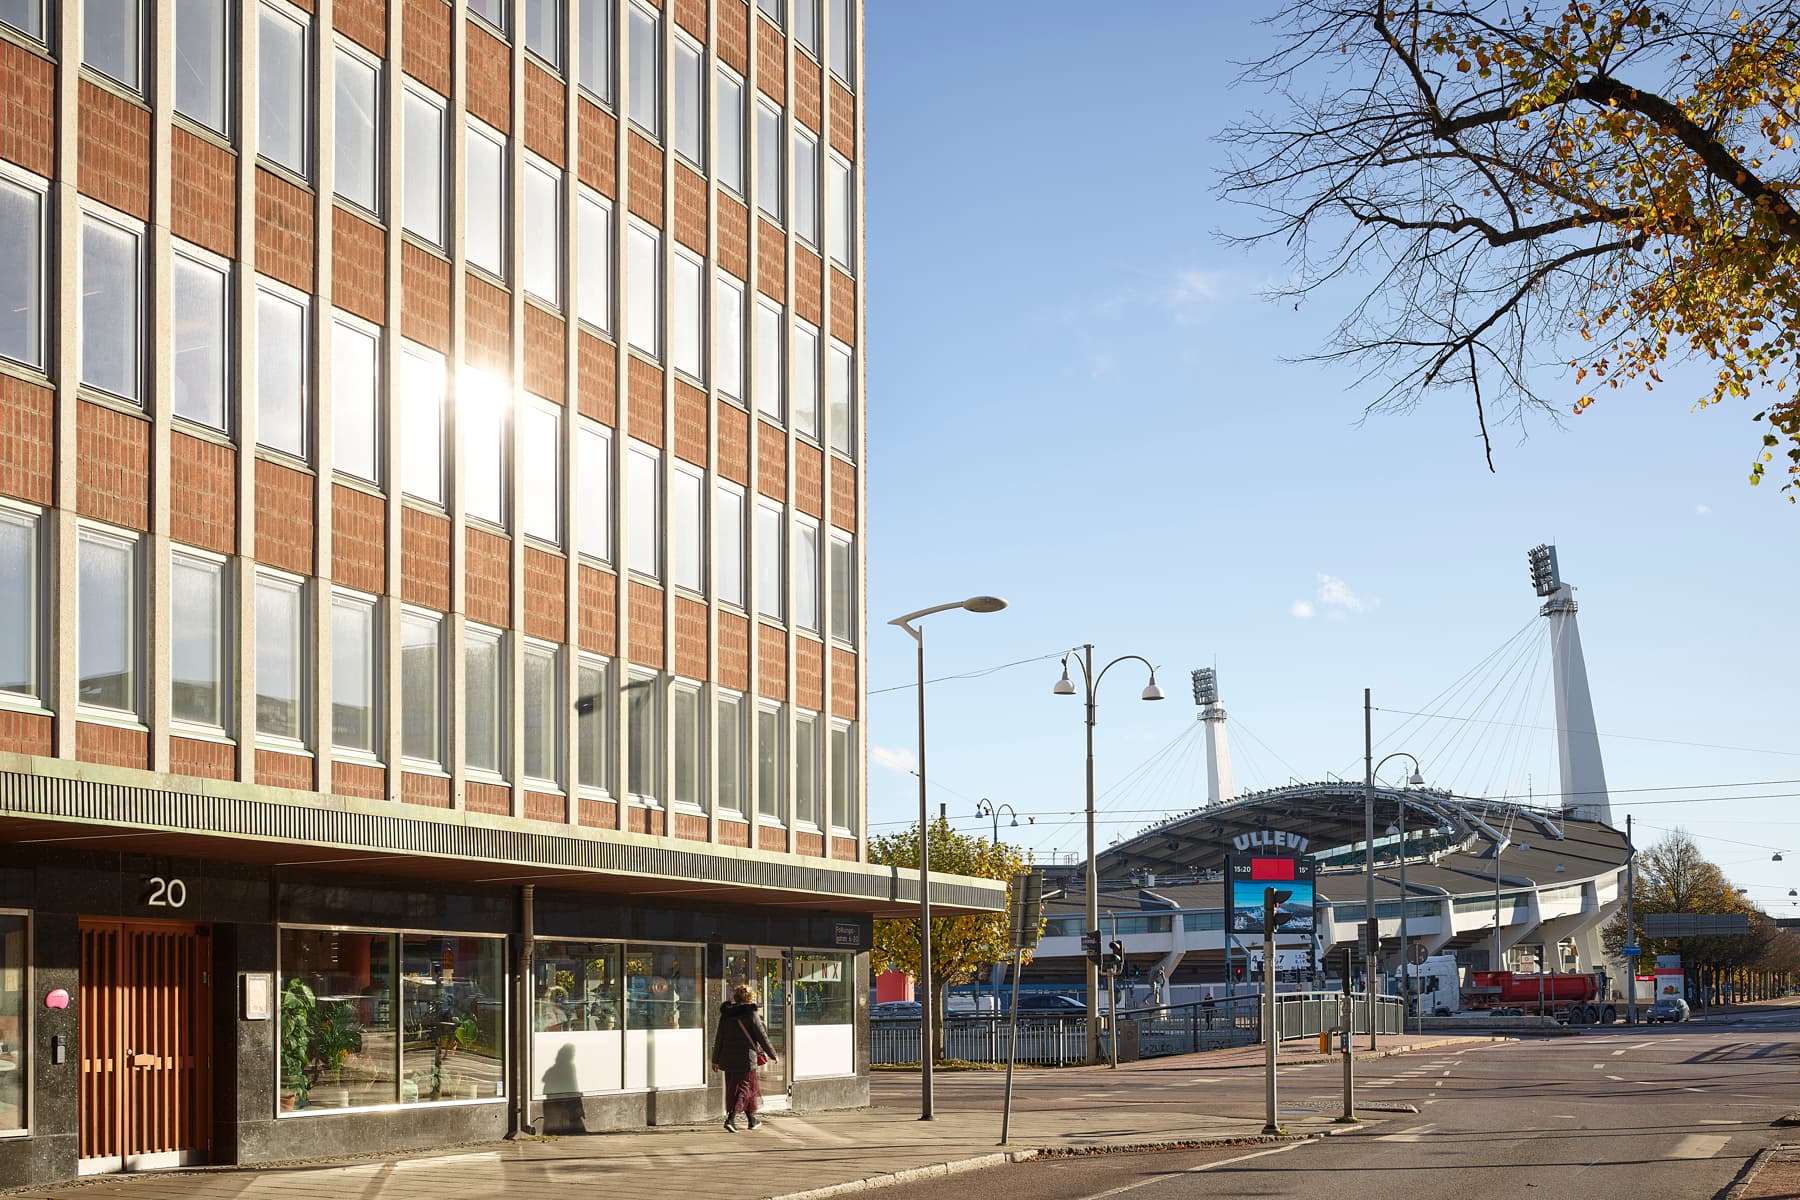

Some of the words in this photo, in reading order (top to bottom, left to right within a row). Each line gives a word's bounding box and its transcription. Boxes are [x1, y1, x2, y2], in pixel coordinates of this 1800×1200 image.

[1232, 831, 1309, 852] ULLEVI
[149, 877, 186, 907] 20
[797, 962, 839, 979] JINX
